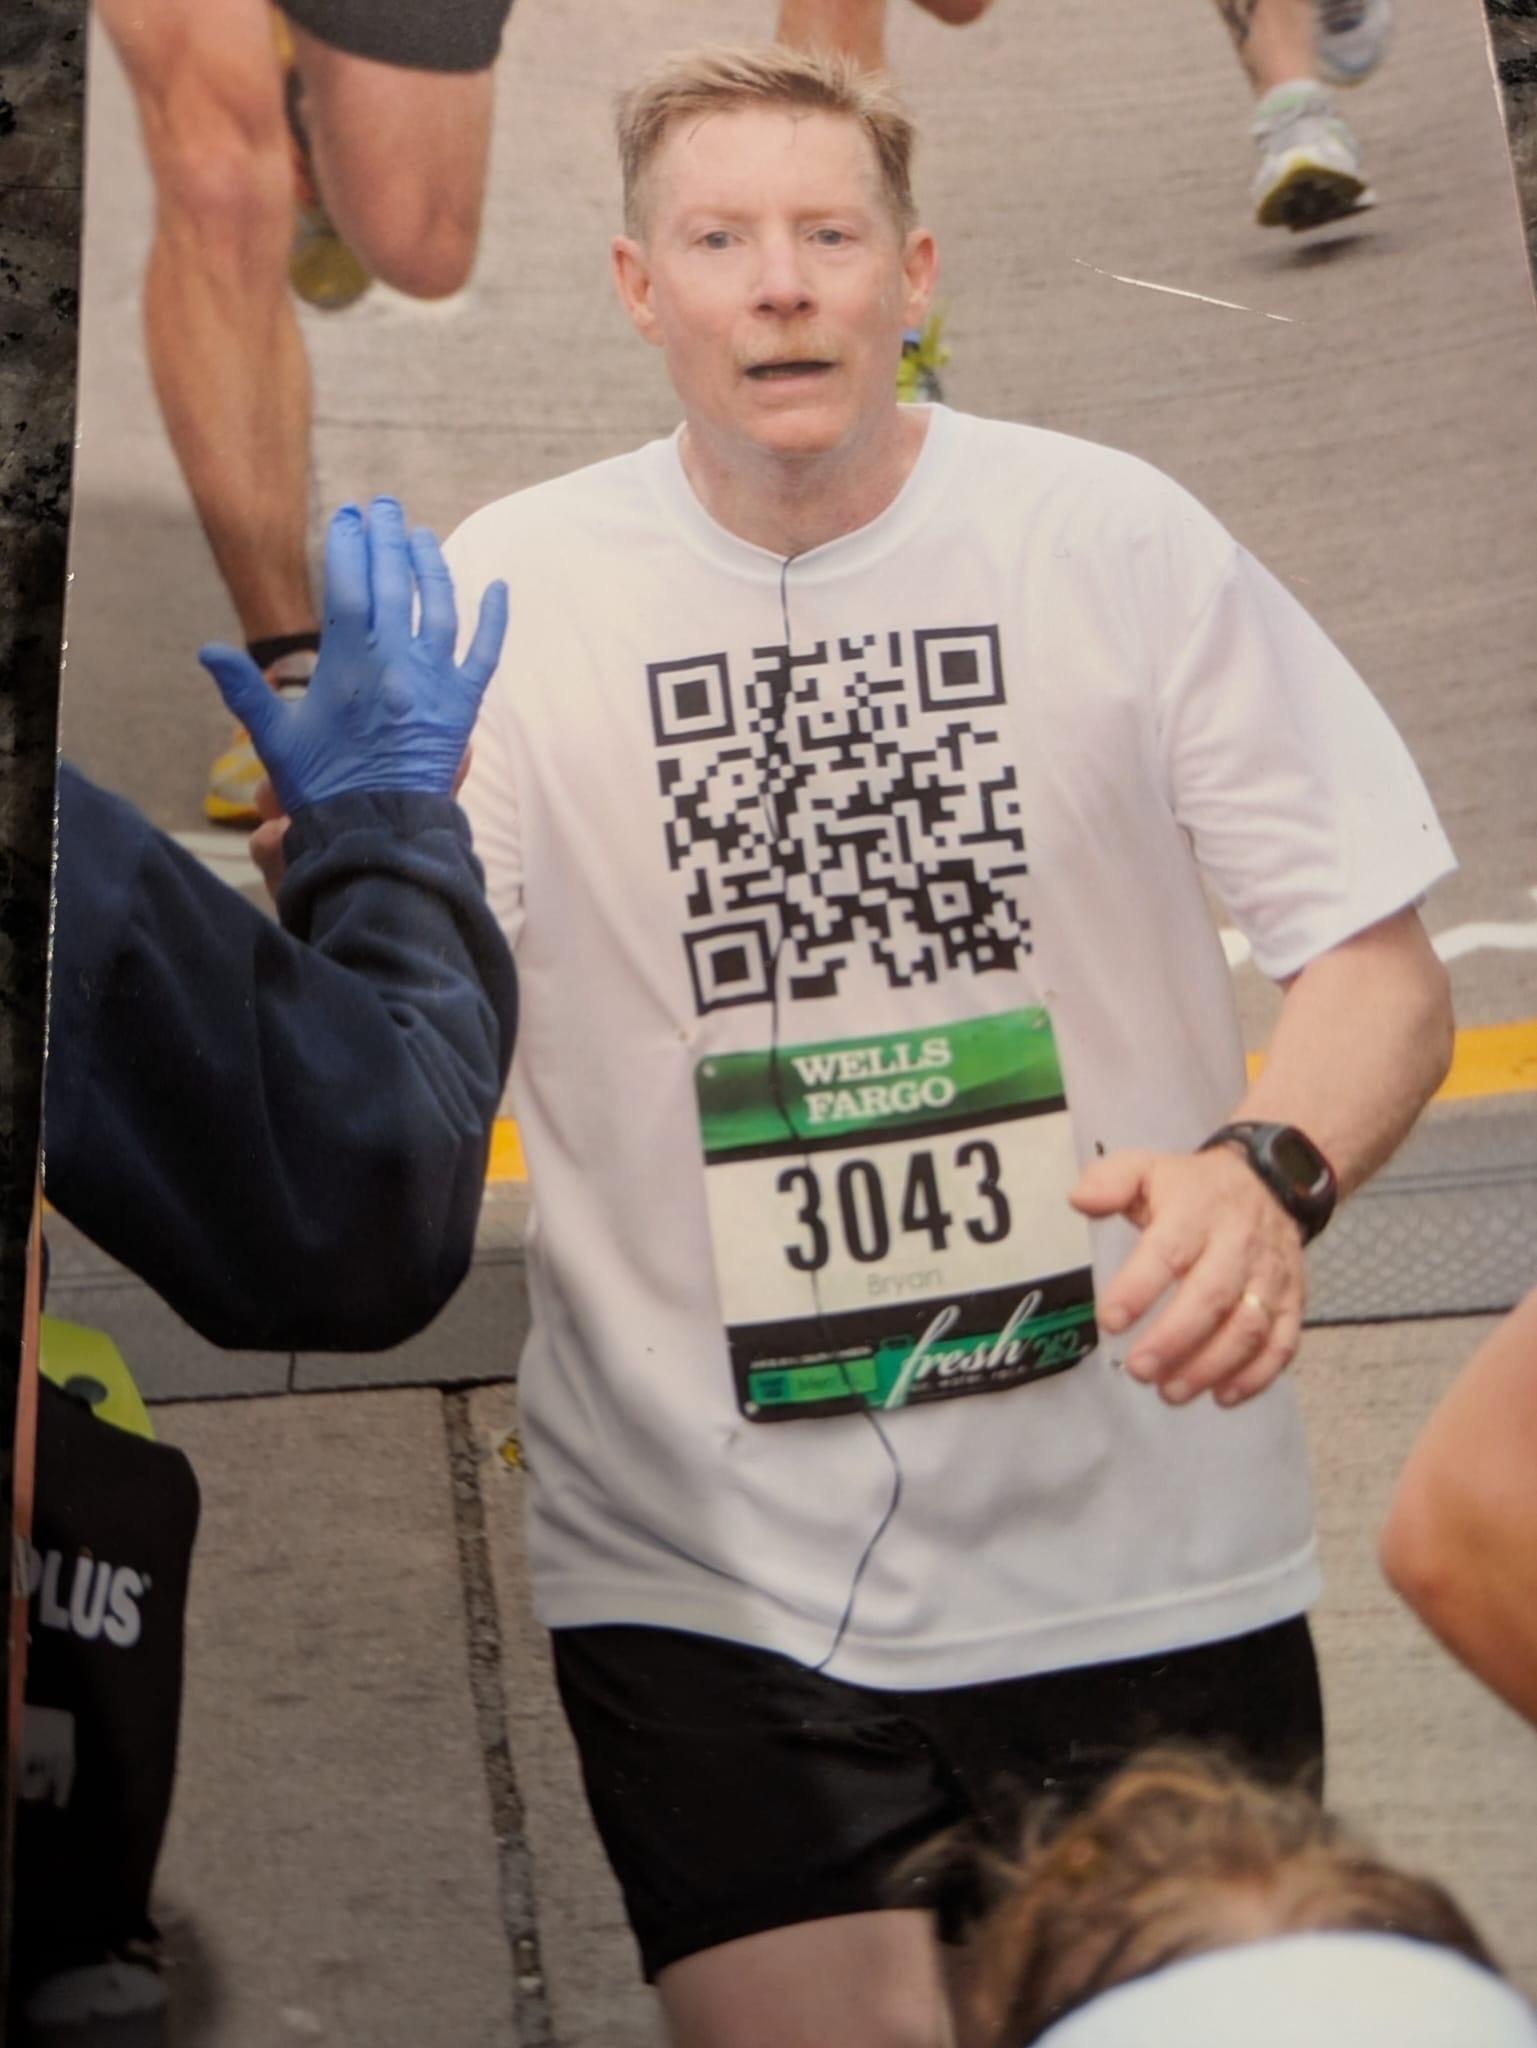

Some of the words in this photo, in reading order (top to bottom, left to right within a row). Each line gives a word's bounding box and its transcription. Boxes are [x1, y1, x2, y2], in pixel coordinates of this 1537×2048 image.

[792, 1037, 951, 1085] WELLS
[804, 1075, 956, 1123] FARGO
[777, 1140, 1011, 1271] 3043
[867, 1268, 944, 1299] Bryan
[884, 1289, 1043, 1410] fresh
